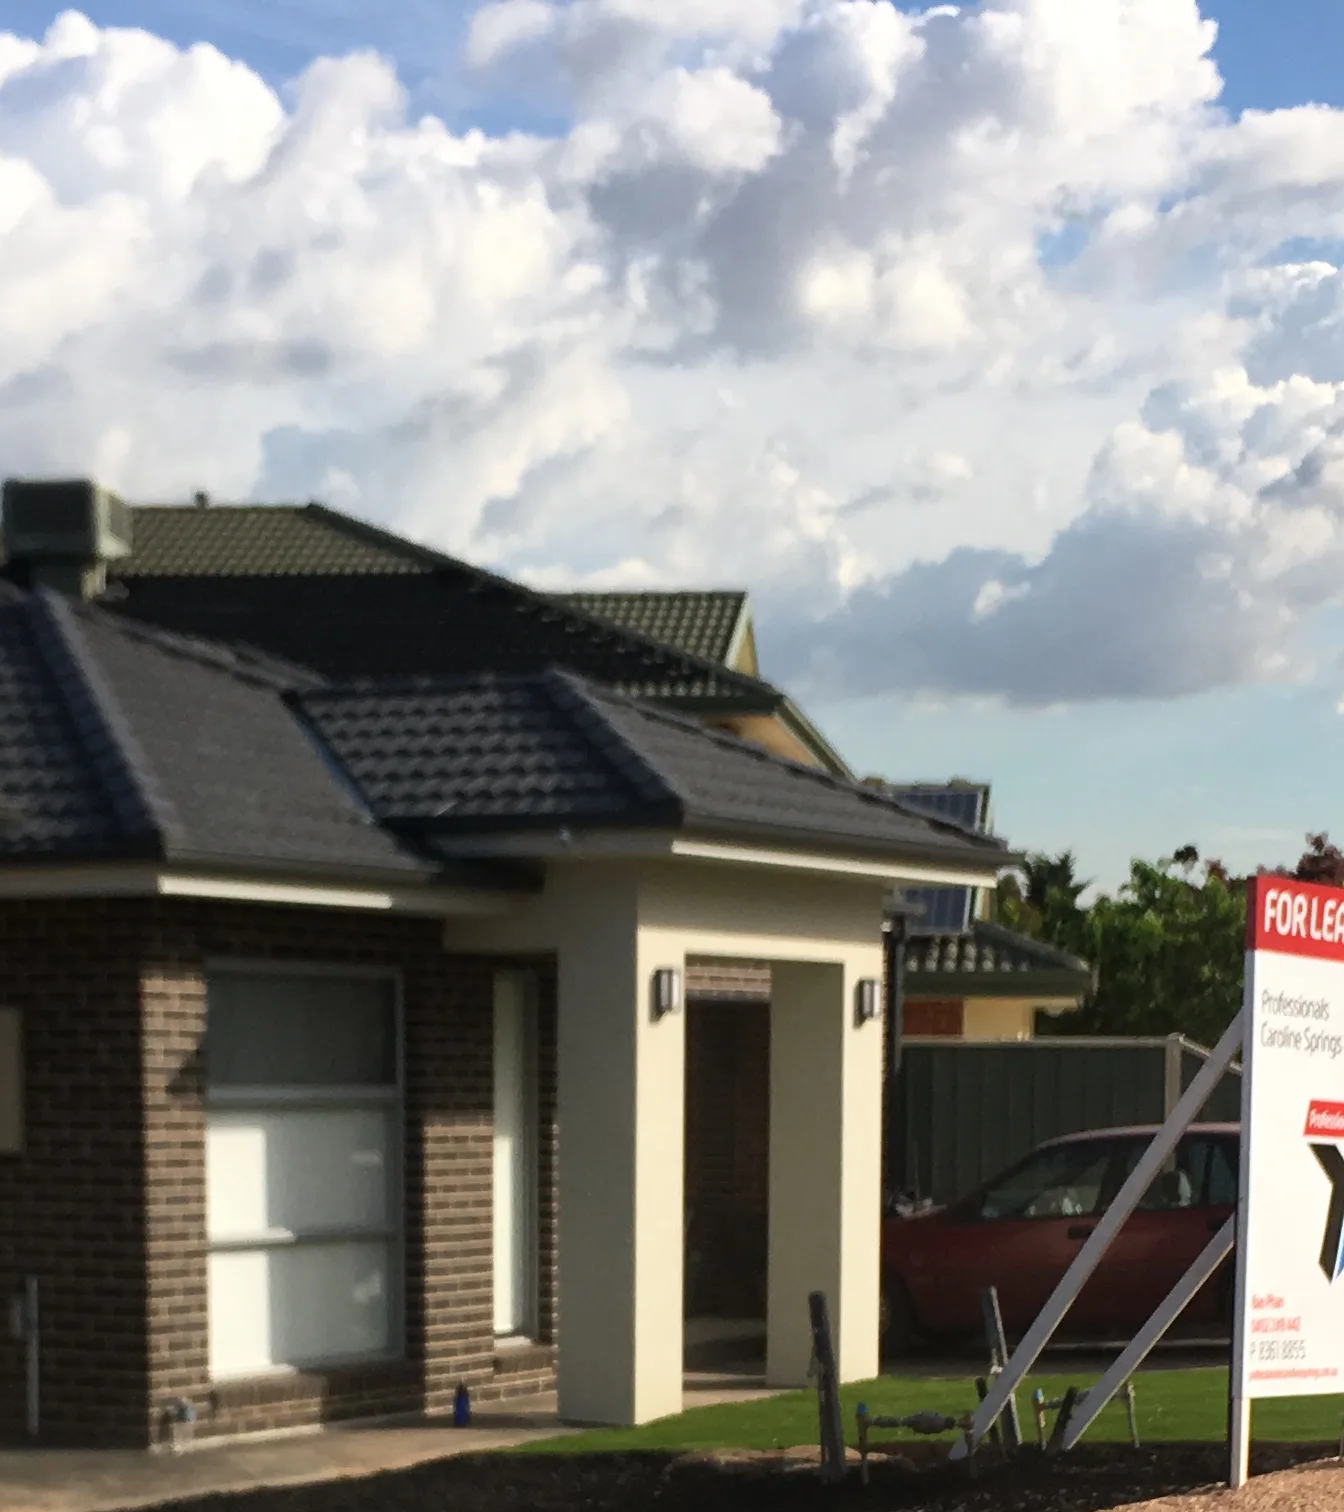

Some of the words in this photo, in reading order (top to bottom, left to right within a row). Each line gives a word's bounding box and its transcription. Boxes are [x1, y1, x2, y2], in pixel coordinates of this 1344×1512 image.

[1264, 887, 1307, 939] FOR
[1261, 988, 1330, 1022] Professionals
[1260, 1020, 1303, 1050] Caroline
[1303, 1026, 1343, 1059] Springs
